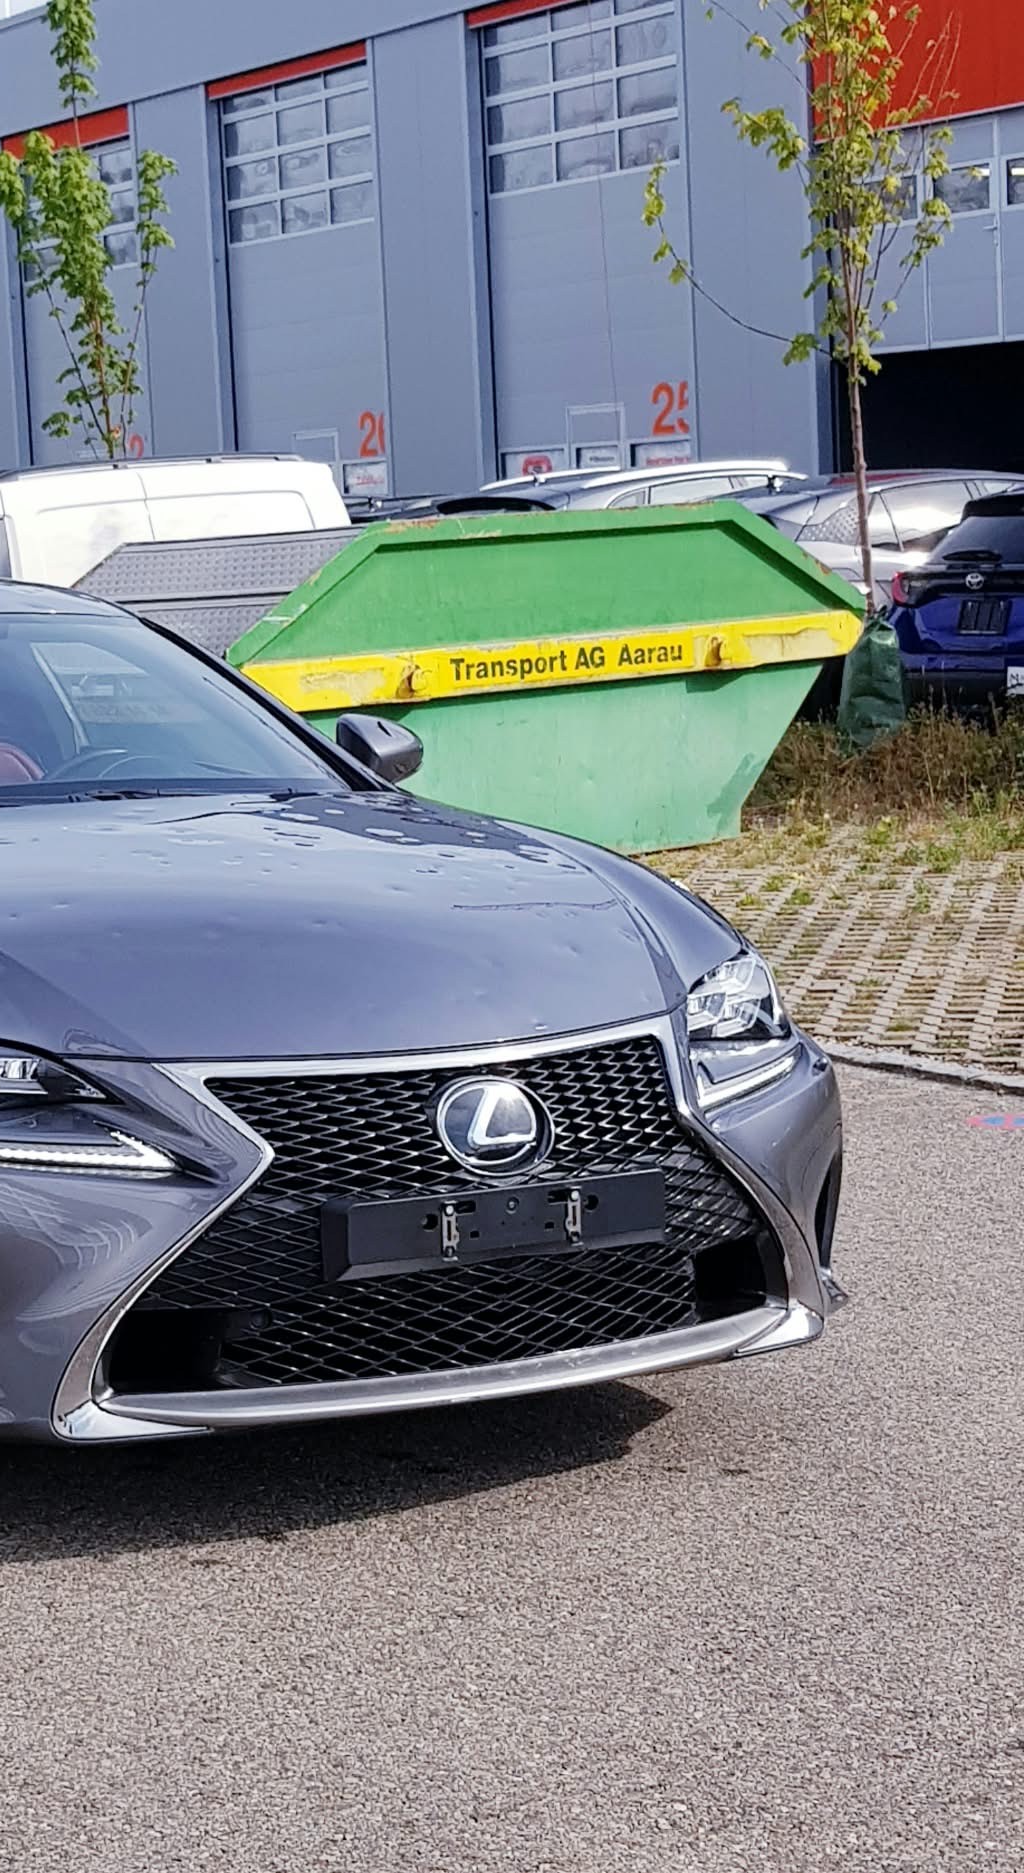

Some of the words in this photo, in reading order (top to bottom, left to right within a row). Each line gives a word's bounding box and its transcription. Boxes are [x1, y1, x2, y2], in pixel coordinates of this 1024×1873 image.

[651, 381, 689, 436] 25
[449, 649, 567, 681] Transport
[575, 646, 605, 670] AG
[617, 643, 683, 667] Aarau
